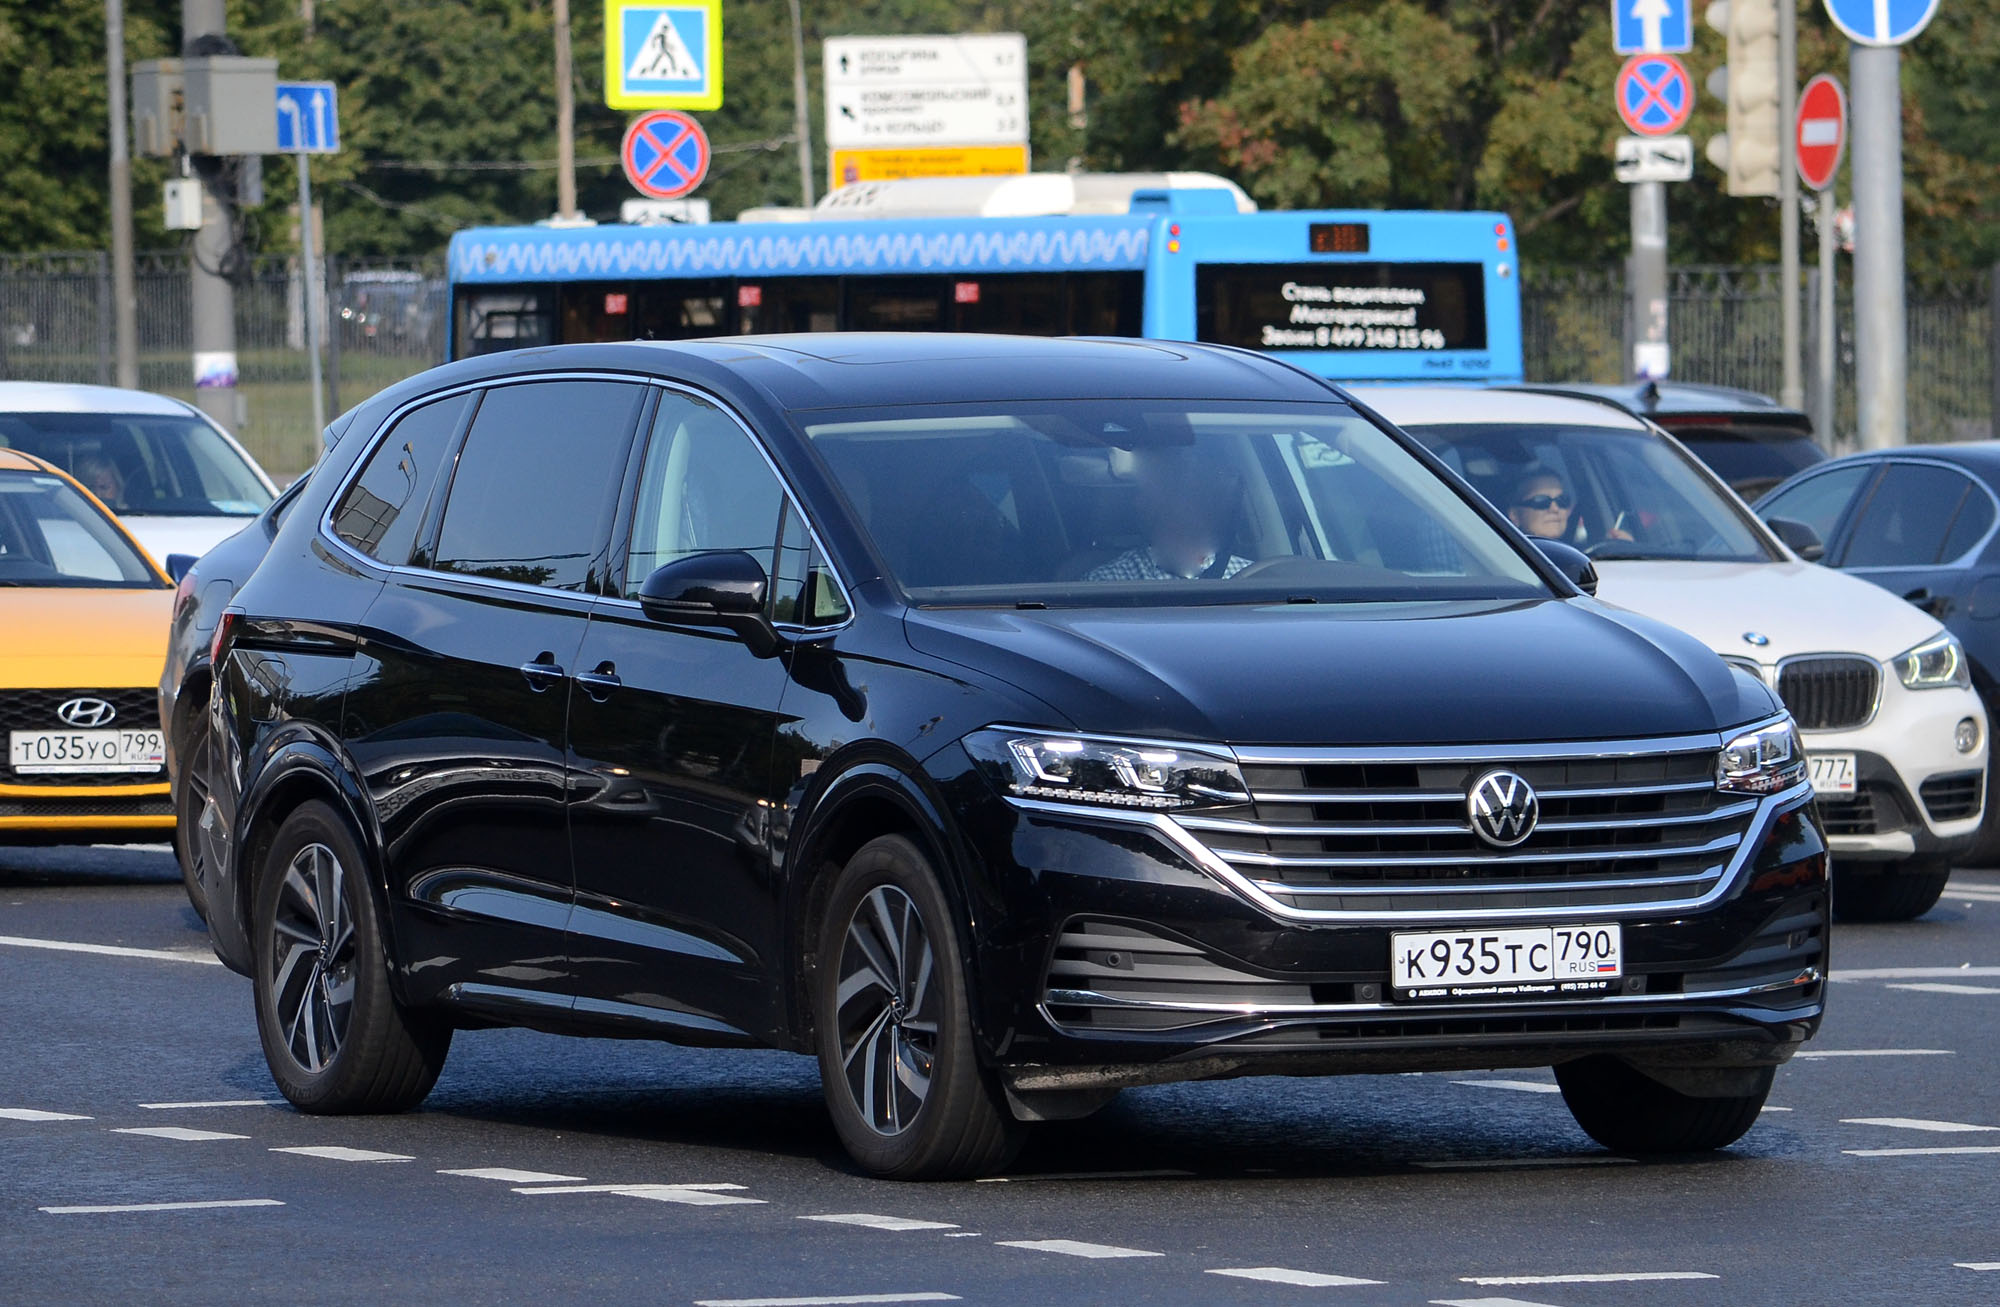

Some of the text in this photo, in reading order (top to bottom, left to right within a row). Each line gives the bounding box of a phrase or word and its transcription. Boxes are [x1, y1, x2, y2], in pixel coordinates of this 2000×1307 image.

[123, 733, 159, 752] 799
[1812, 758, 1848, 780] 777
[1556, 930, 1611, 961] 790
[1569, 961, 1596, 973] RUS
